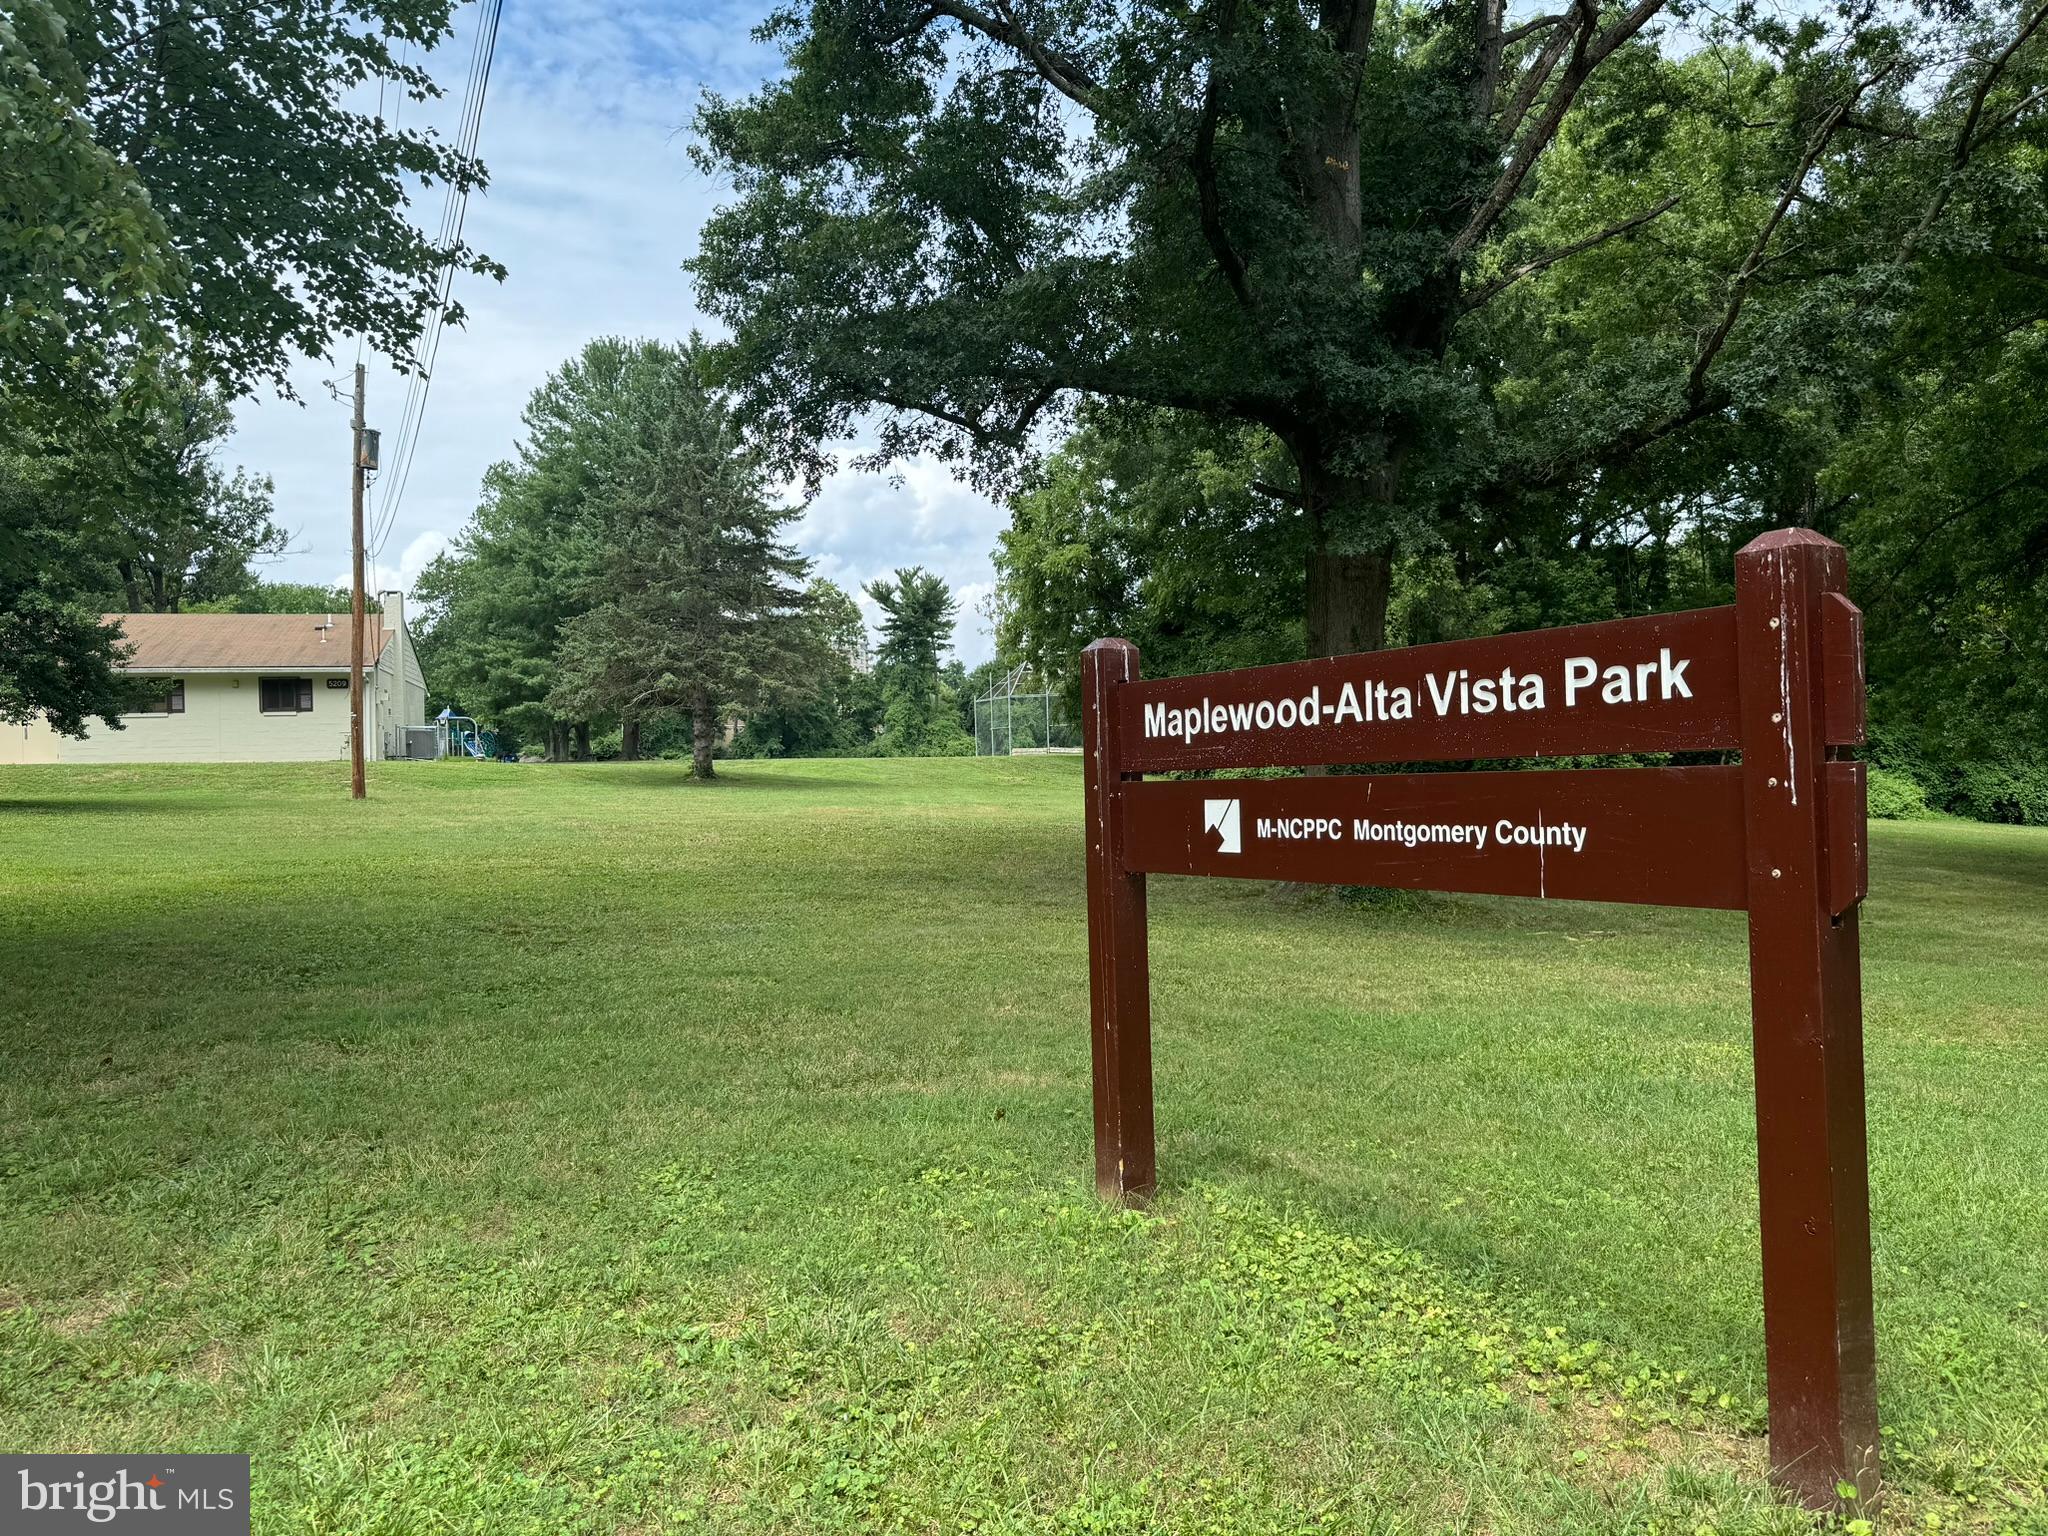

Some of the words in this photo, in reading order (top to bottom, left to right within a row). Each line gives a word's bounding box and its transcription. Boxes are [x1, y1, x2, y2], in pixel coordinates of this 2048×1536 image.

[1143, 678, 1413, 744] Maplewood-Alta
[1425, 666, 1545, 717] Vista
[1564, 647, 1694, 708] Park
[1256, 817, 1342, 841] M-NCPPC
[1353, 818, 1488, 850] Montgomery
[1495, 818, 1587, 853] County
